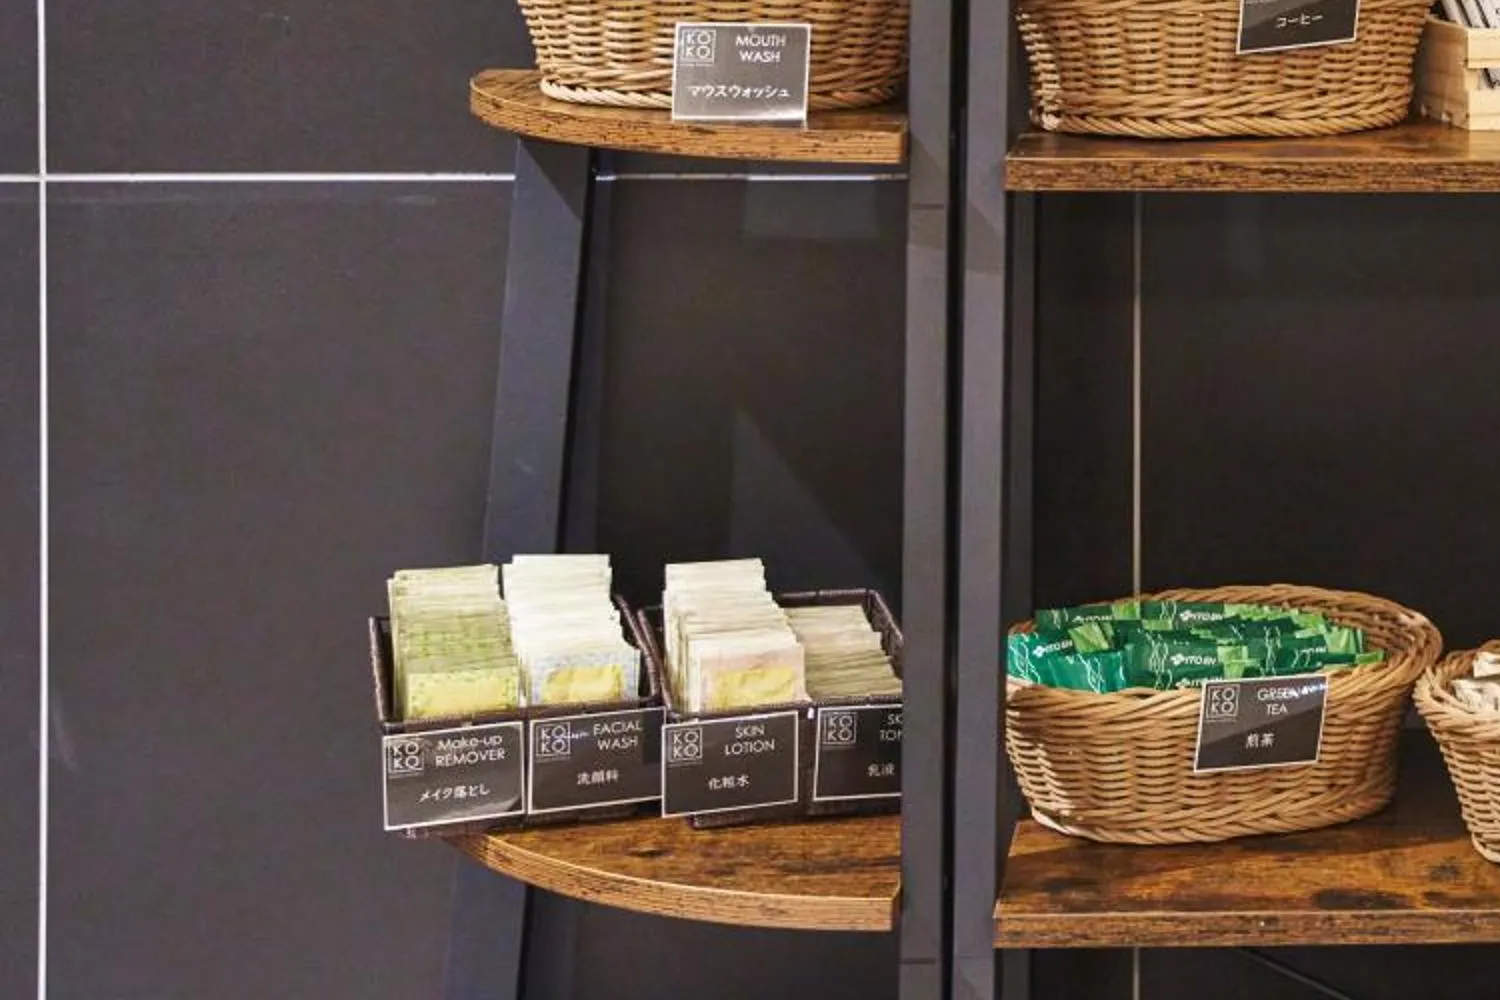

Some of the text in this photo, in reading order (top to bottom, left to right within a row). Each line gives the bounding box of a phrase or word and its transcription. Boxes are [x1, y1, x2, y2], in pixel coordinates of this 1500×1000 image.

[1275, 13, 1324, 28] コーヒー
[736, 34, 787, 47] MOUTH
[739, 50, 781, 63] WASH
[686, 84, 791, 98] マウスウォッシュ
[1266, 703, 1288, 716] TEA
[593, 720, 642, 736] FACIAL
[597, 736, 639, 751] WASH
[724, 739, 775, 755] LOTION
[435, 748, 505, 768] REMOVER
